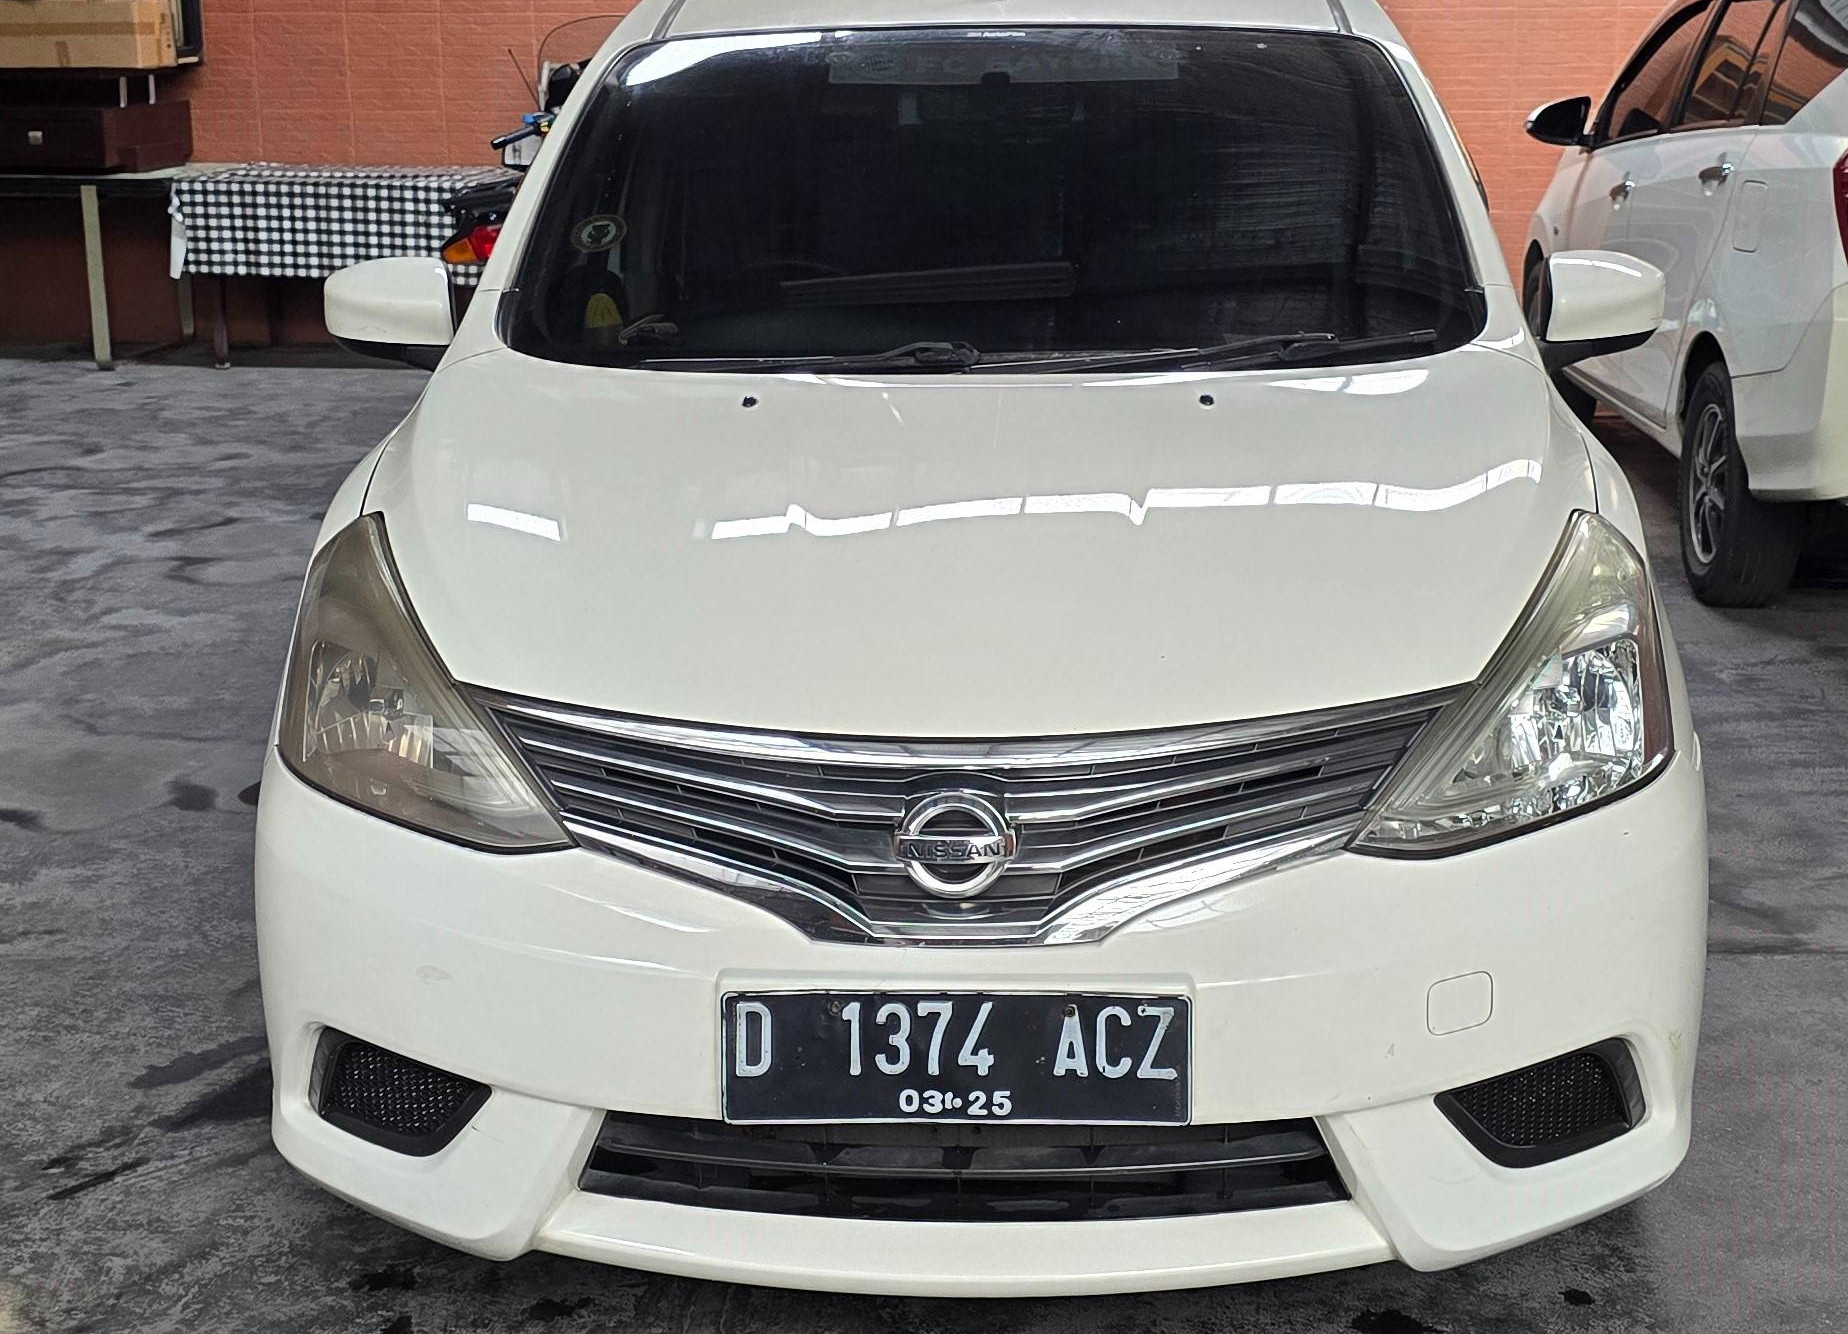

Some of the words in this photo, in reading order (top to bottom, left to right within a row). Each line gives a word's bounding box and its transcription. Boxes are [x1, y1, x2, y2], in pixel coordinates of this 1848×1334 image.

[906, 841, 1001, 859] NISSAN
[735, 1001, 773, 1078] D
[840, 1001, 995, 1077] 1374
[1053, 1004, 1179, 1081] ACZ
